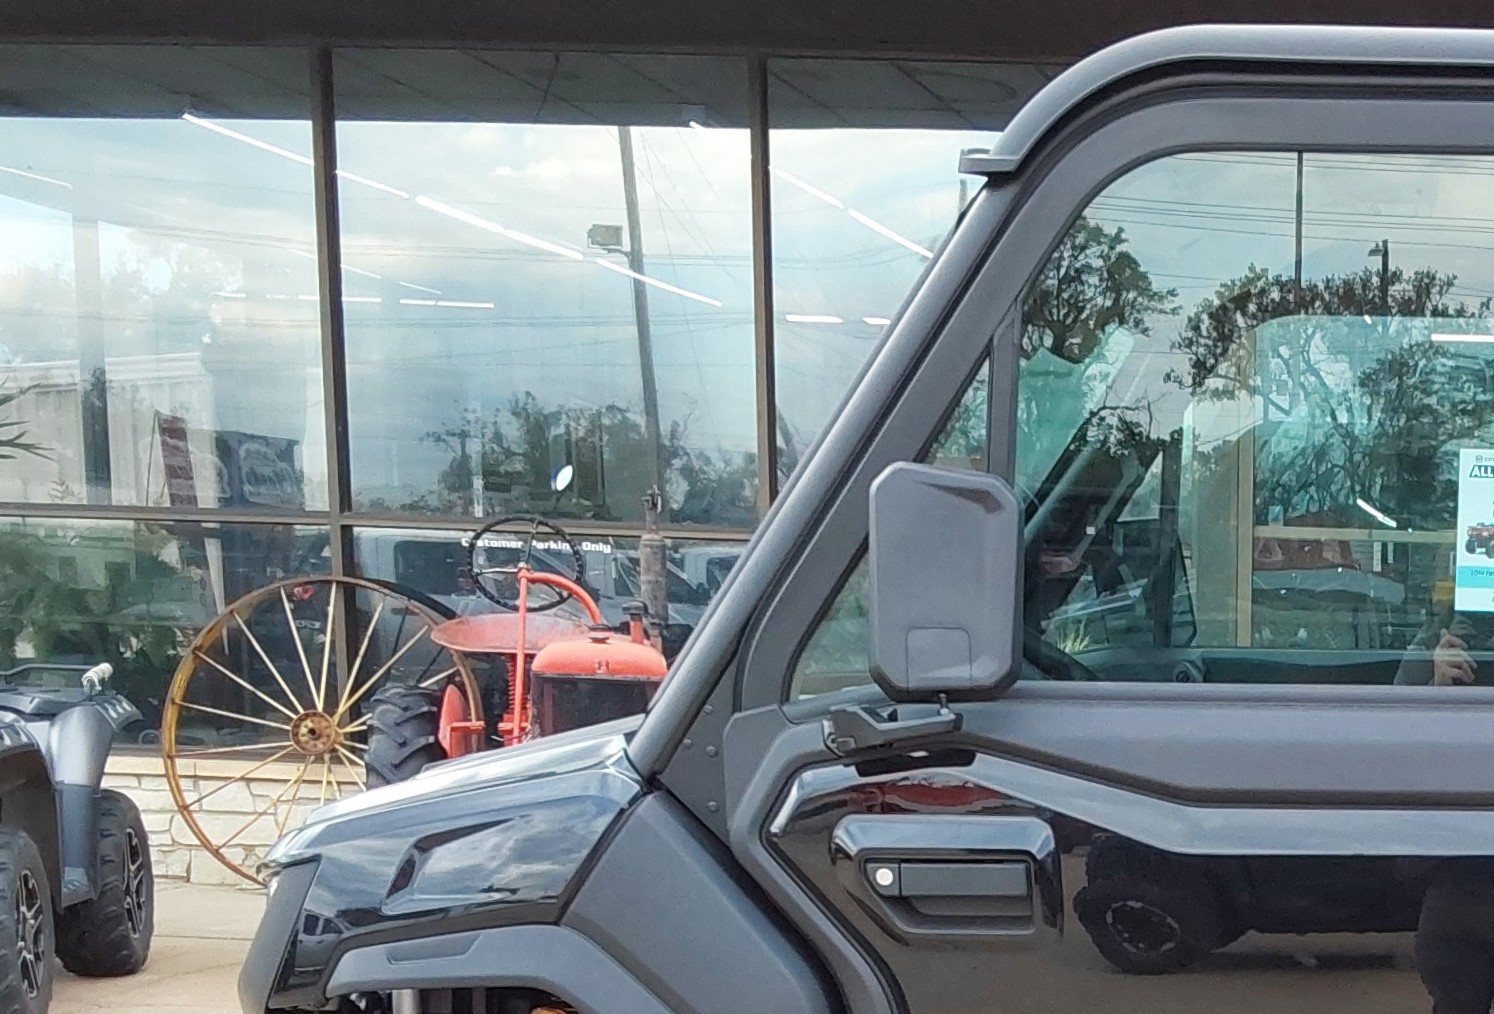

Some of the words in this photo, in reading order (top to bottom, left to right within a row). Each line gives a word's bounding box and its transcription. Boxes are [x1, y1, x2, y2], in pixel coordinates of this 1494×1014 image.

[1472, 465, 1494, 477] ALL
[461, 537, 524, 549] Cstomer
[581, 541, 612, 554] Only
